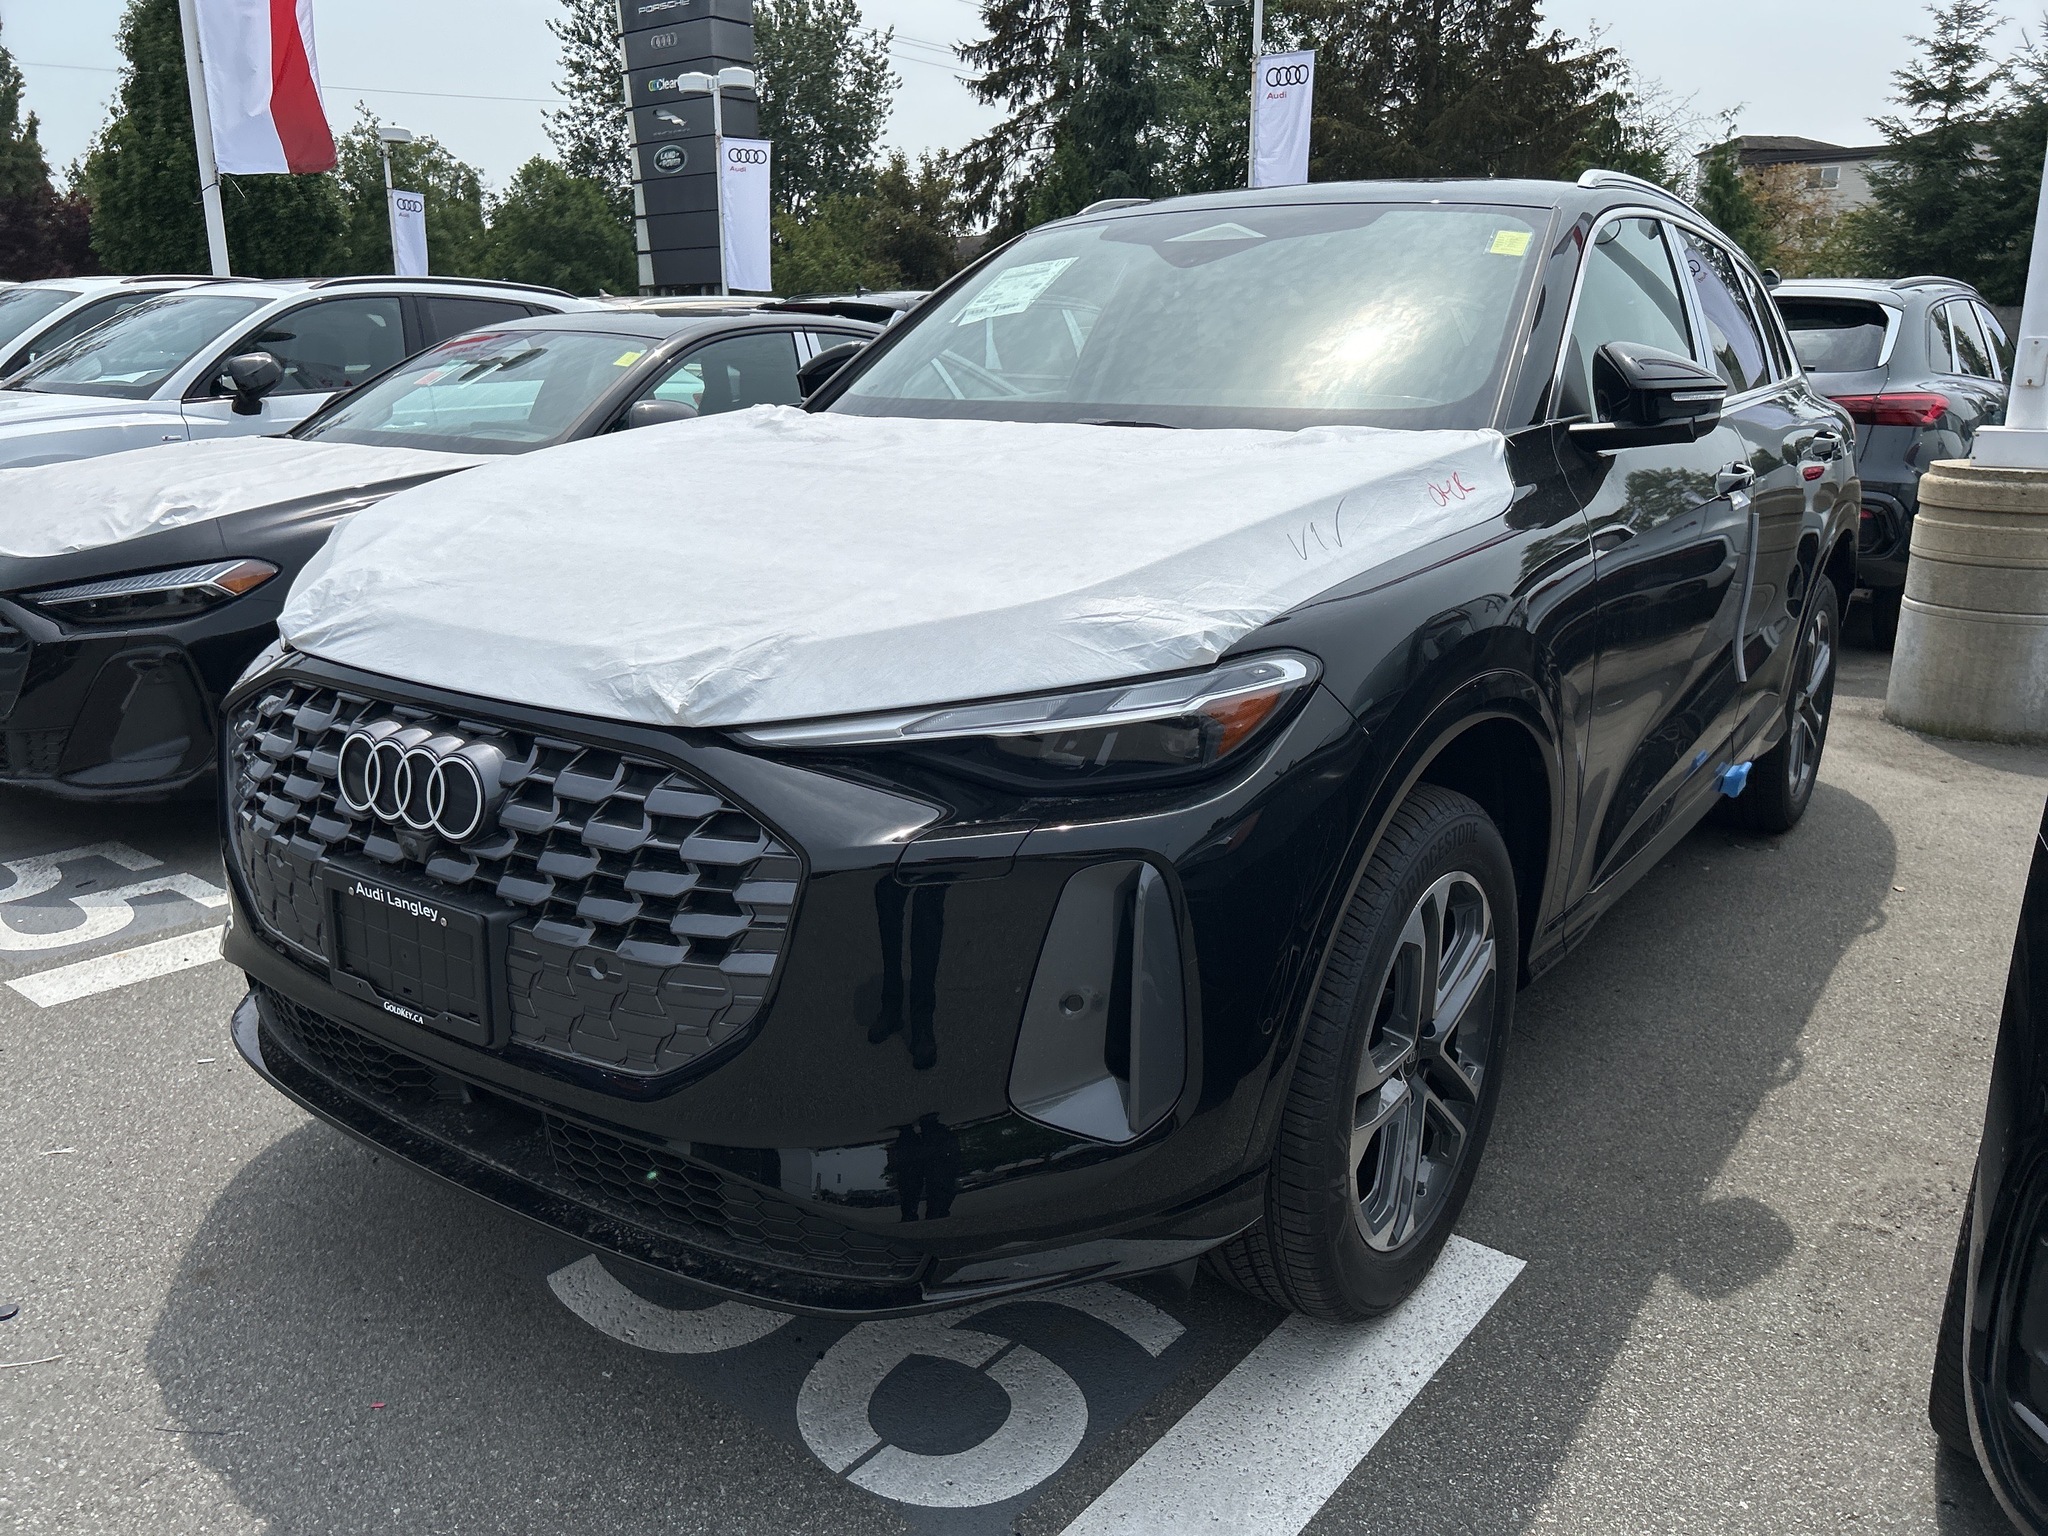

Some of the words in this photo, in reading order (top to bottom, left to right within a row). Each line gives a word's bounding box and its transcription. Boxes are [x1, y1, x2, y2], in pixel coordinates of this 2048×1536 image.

[638, 0, 690, 14] PORSCHE
[1266, 91, 1287, 100] Audi
[1392, 821, 1479, 916] BRIDGESTONE
[356, 881, 385, 903] Audi
[386, 891, 438, 922] Langley
